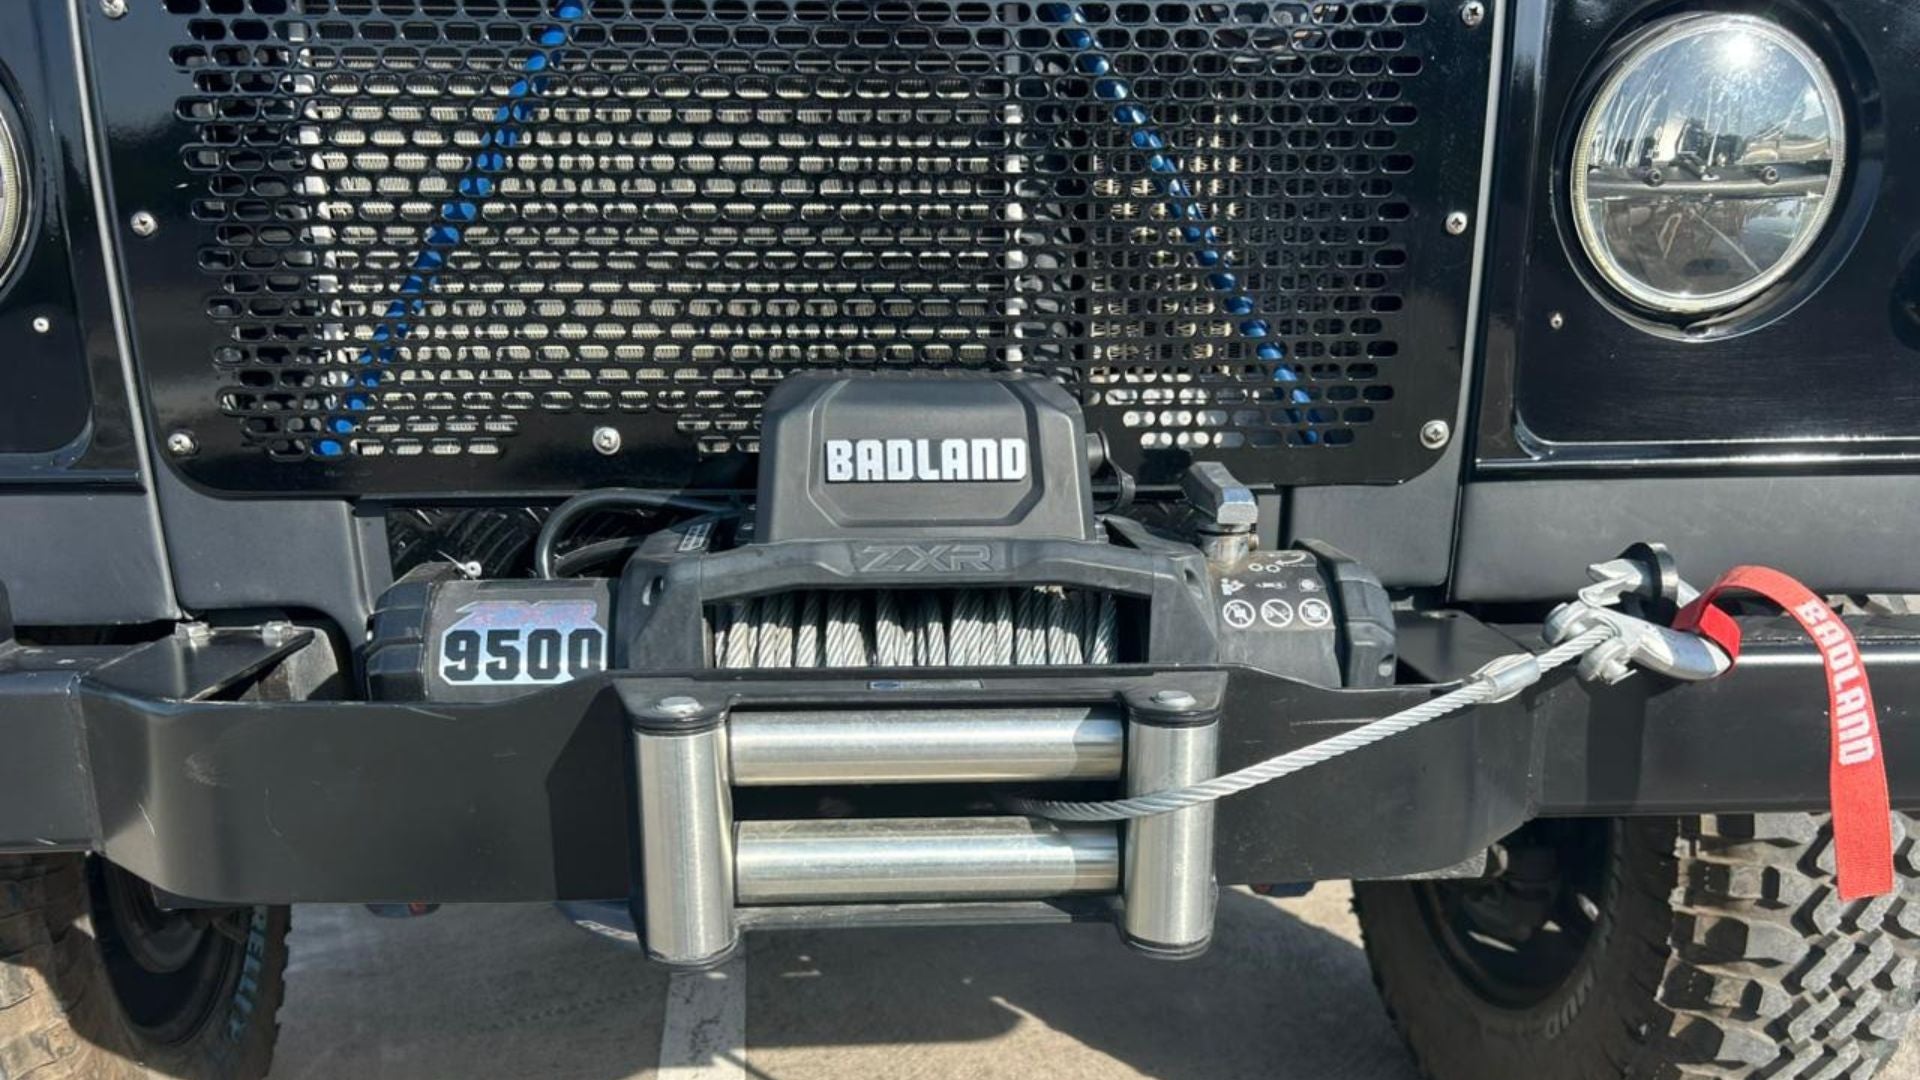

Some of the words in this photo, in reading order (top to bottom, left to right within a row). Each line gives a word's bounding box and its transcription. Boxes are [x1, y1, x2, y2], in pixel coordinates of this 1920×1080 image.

[825, 437, 1028, 482] BADLAND
[860, 544, 993, 573] ZXR
[444, 628, 602, 681] 9500
[1794, 600, 1875, 765] BADLAND
